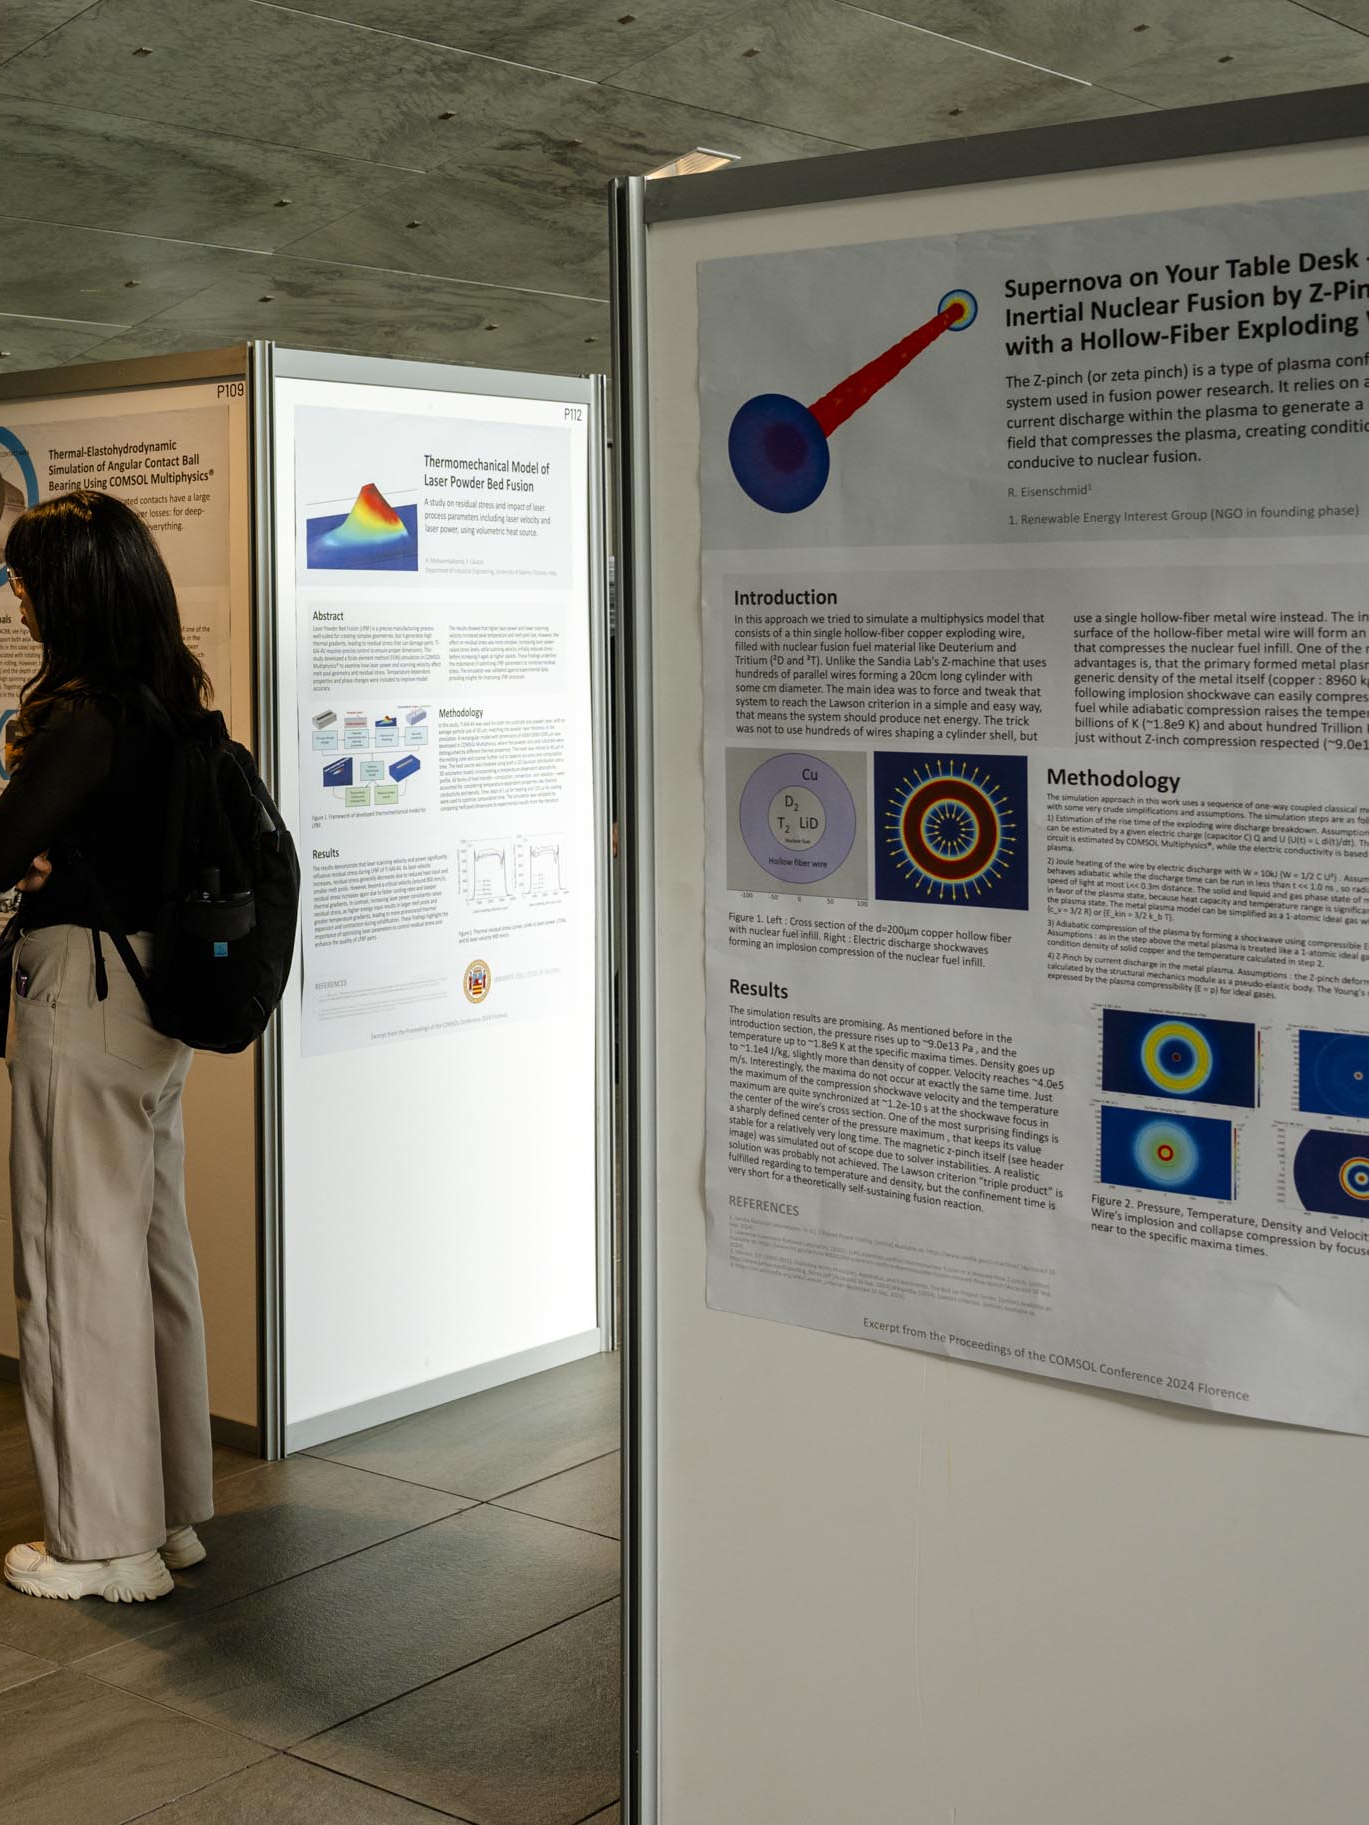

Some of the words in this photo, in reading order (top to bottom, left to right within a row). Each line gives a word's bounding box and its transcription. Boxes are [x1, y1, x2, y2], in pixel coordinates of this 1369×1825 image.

[1004, 273, 1122, 300] Supernova
[1129, 270, 1158, 287] on
[1165, 263, 1219, 284] Your
[1224, 253, 1290, 278] Table
[1298, 247, 1359, 272] Desk
[1006, 300, 1083, 327] Inertial
[1090, 296, 1180, 320] Nuclear
[1187, 289, 1264, 312] Fusion
[1272, 284, 1302, 310] by
[1005, 333, 1053, 356] with
[1060, 337, 1072, 352] a
[1080, 322, 1230, 351] Hollow-Fiber
[1237, 313, 1359, 343] Exploding
[1004, 375, 1030, 388] The
[1033, 370, 1083, 389] Z-pinch
[1087, 369, 1107, 386] (or
[1110, 368, 1139, 381] zeta
[1144, 363, 1188, 382] pinch)
[1192, 363, 1203, 376] is
[1207, 365, 1216, 376] a
[1220, 362, 1254, 377] type
[1257, 357, 1273, 373] of
[1277, 356, 1331, 374] plasma
[217, 382, 244, 399] P109
[564, 407, 582, 421] P112
[48, 439, 176, 460] Thermal-Elastohydrodynamic
[1007, 454, 1075, 470] conducive
[1077, 454, 1093, 466] to
[1097, 451, 1149, 465] nuclear
[1152, 449, 1201, 463] fusion.
[48, 462, 94, 476] Simulation
[96, 460, 106, 472] of
[107, 458, 142, 473] Angular
[144, 456, 179, 468] Contact
[182, 453, 199, 466] Ball
[423, 453, 509, 472] Thermomechanical
[511, 460, 538, 474] Model
[540, 462, 550, 475] of
[48, 479, 82, 493] Bearing
[81, 477, 107, 492] Using
[108, 473, 149, 487] COMSOL
[424, 473, 448, 487] Laser
[450, 475, 485, 489] Powder
[486, 477, 503, 490] Bed
[506, 478, 534, 492] Fusion
[1007, 487, 1017, 497] R.
[139, 495, 168, 504] contacts
[168, 493, 186, 503] have
[193, 492, 211, 503] large
[423, 497, 429, 506] A
[429, 498, 446, 509] study
[446, 499, 454, 507] on
[454, 498, 477, 508] residual
[478, 500, 494, 509] stress
[495, 501, 506, 510] and
[506, 503, 525, 512] impact
[525, 502, 532, 511] of
[531, 502, 545, 512] laser
[149, 508, 171, 518] losses:
[172, 506, 183, 516] for
[184, 506, 205, 517] deep-
[1008, 514, 1018, 526] 1.
[1020, 512, 1080, 525] Renewable
[1082, 512, 1121, 525] Energy
[1123, 511, 1168, 522] Interest
[1170, 509, 1207, 522] Group
[1210, 507, 1243, 521] (NGO
[1246, 507, 1257, 518] in
[1259, 505, 1315, 519] founding
[1317, 503, 1359, 519] phase)
[734, 588, 837, 605] Introduction
[312, 610, 343, 621] Abstract
[438, 707, 483, 718] Methodology
[801, 768, 818, 781] Cu
[1047, 768, 1180, 793] Methodology
[799, 816, 819, 830] LiD
[312, 847, 339, 859] Results
[768, 856, 793, 866] Hollow
[793, 857, 810, 867] fiber
[729, 978, 788, 999] Results
[728, 1194, 799, 1216] REFERENCES
[1090, 1222, 1114, 1232] near
[1116, 1225, 1127, 1235] to
[1129, 1226, 1146, 1238] the
[1148, 1231, 1188, 1245] specific
[1190, 1237, 1232, 1251] maxima
[1234, 1242, 1268, 1256] times.
[863, 1316, 900, 1334] Excerpt
[902, 1323, 927, 1340] from
[929, 1328, 948, 1343] the
[948, 1333, 1012, 1357] Proceedings
[1013, 1347, 1025, 1358] of
[1027, 1349, 1046, 1362] the
[1048, 1353, 1097, 1373] COMSOL
[1099, 1363, 1163, 1386] Conference
[1166, 1375, 1195, 1392] 2024
[1197, 1382, 1249, 1401] Florence
